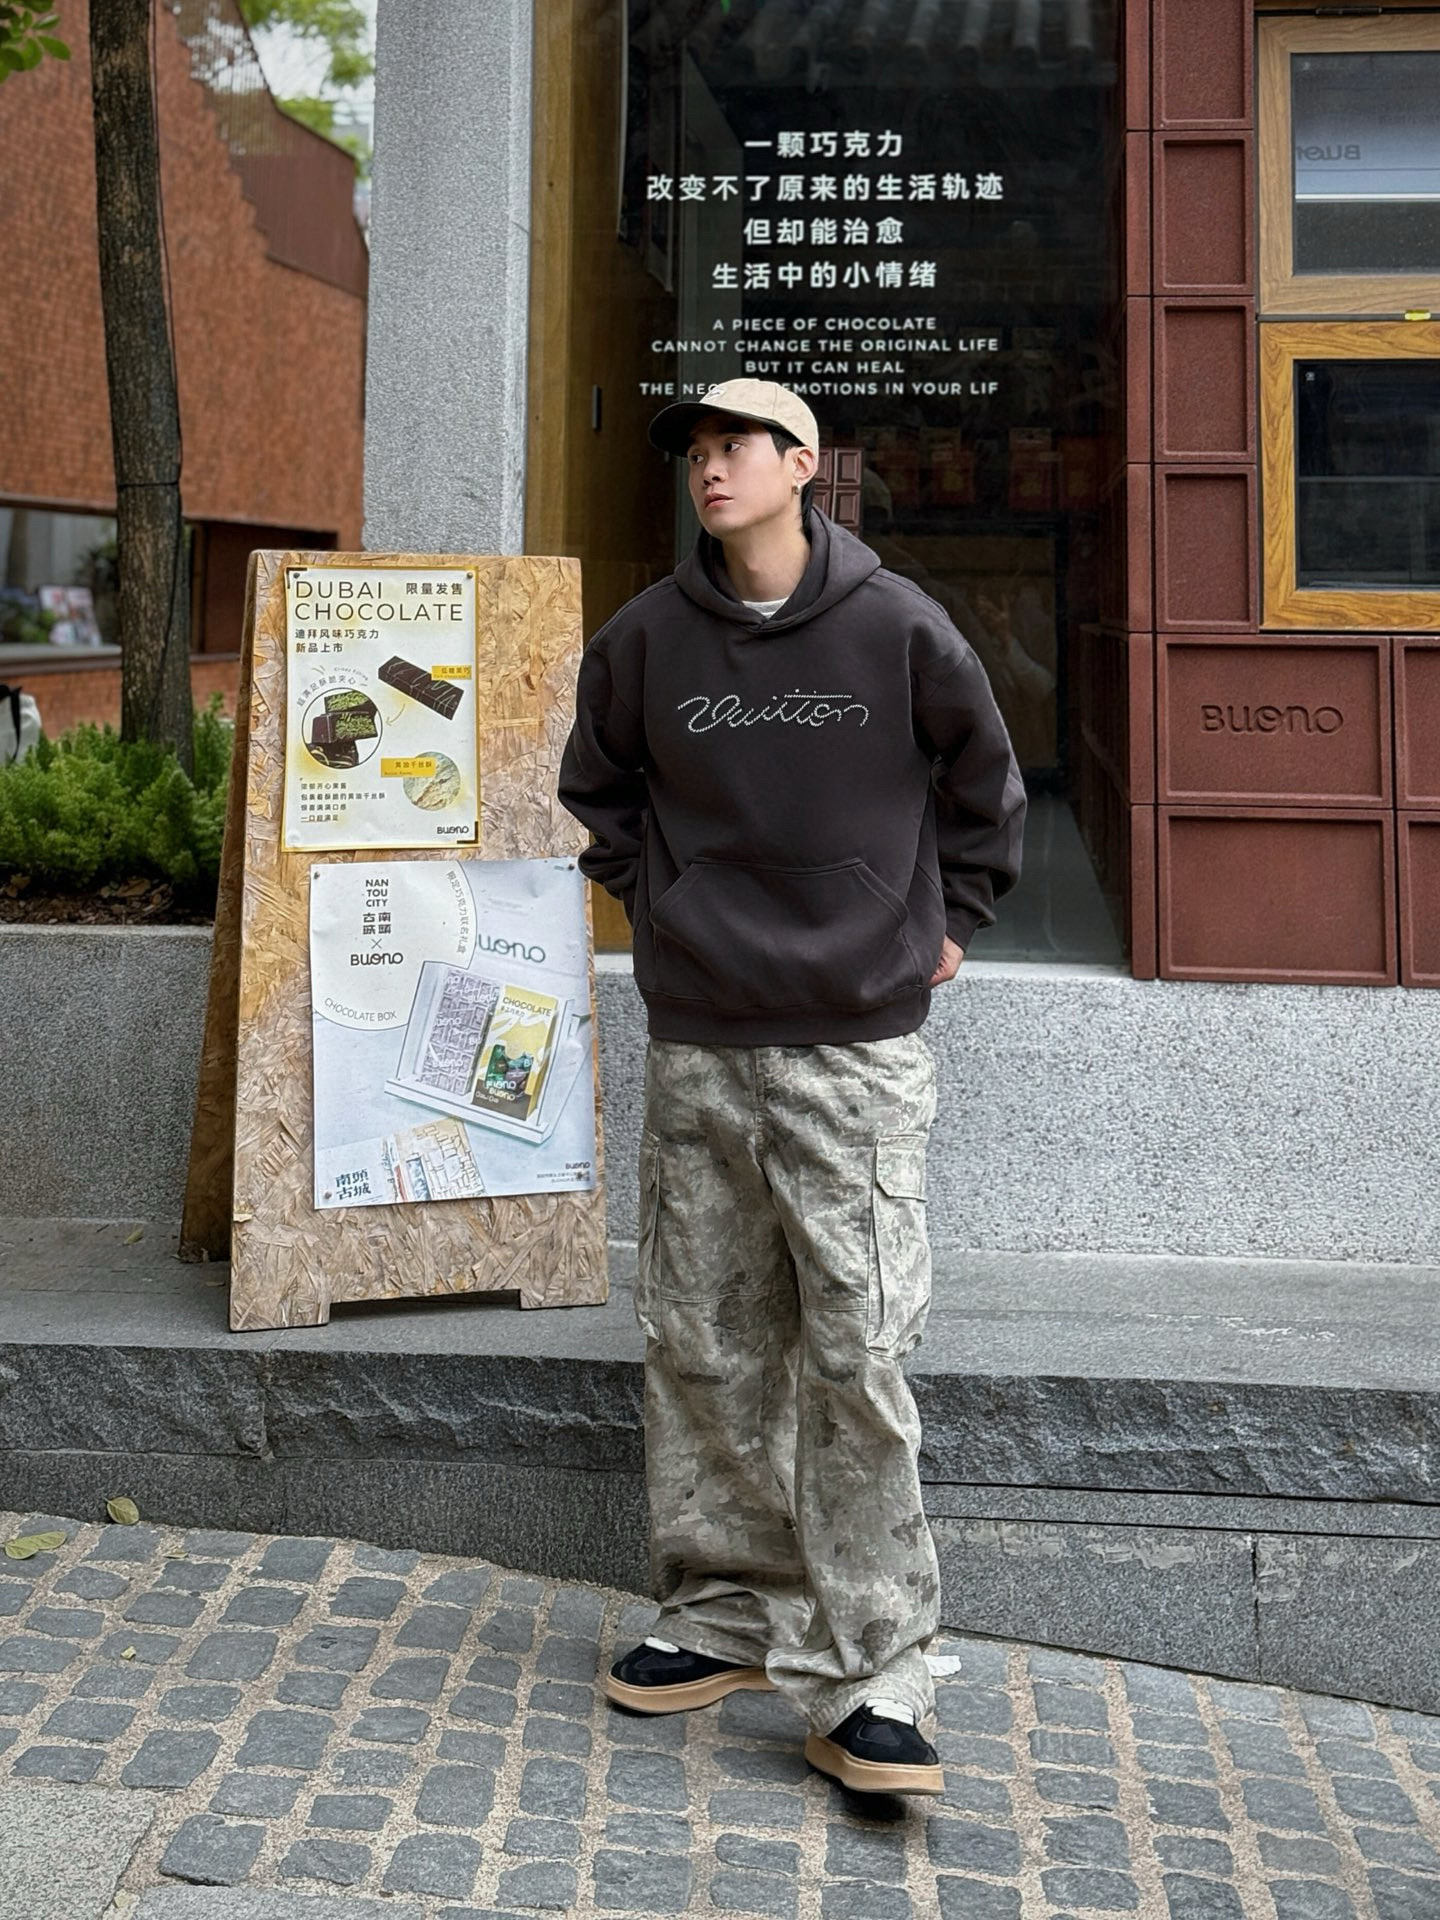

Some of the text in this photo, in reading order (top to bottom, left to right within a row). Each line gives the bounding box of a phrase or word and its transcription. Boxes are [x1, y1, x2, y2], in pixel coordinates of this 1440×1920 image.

[745, 130, 903, 158] 一颗巧克力
[646, 173, 1004, 202] 改变不了原来的生活轨迹
[743, 217, 904, 246] 但却能治愈
[712, 261, 938, 290] 生活中的小情绪
[712, 317, 937, 331] A PIECE OF CHOCOLATE
[651, 338, 998, 353] CANNOT CHANGE THE ORIGINAL LIFE
[745, 361, 905, 374] BUT IT CAN HEAL
[639, 382, 675, 396] THE
[885, 382, 904, 394] IN
[912, 382, 962, 395] YOUR
[970, 382, 998, 395] LIF
[295, 581, 382, 599] DUBAI
[406, 582, 463, 596] 限量发售
[295, 603, 463, 621] CHOCOLATE
[294, 628, 379, 639] 迪拜风味巧克力
[296, 642, 343, 653] 新品上市
[365, 879, 389, 887] NAN
[366, 889, 388, 897] TOU
[366, 899, 388, 907] CITY
[324, 997, 398, 1022] CHOCOLATE BOX
[502, 996, 552, 1017] CHOCOLATE
[336, 1182, 372, 1200] 古城
